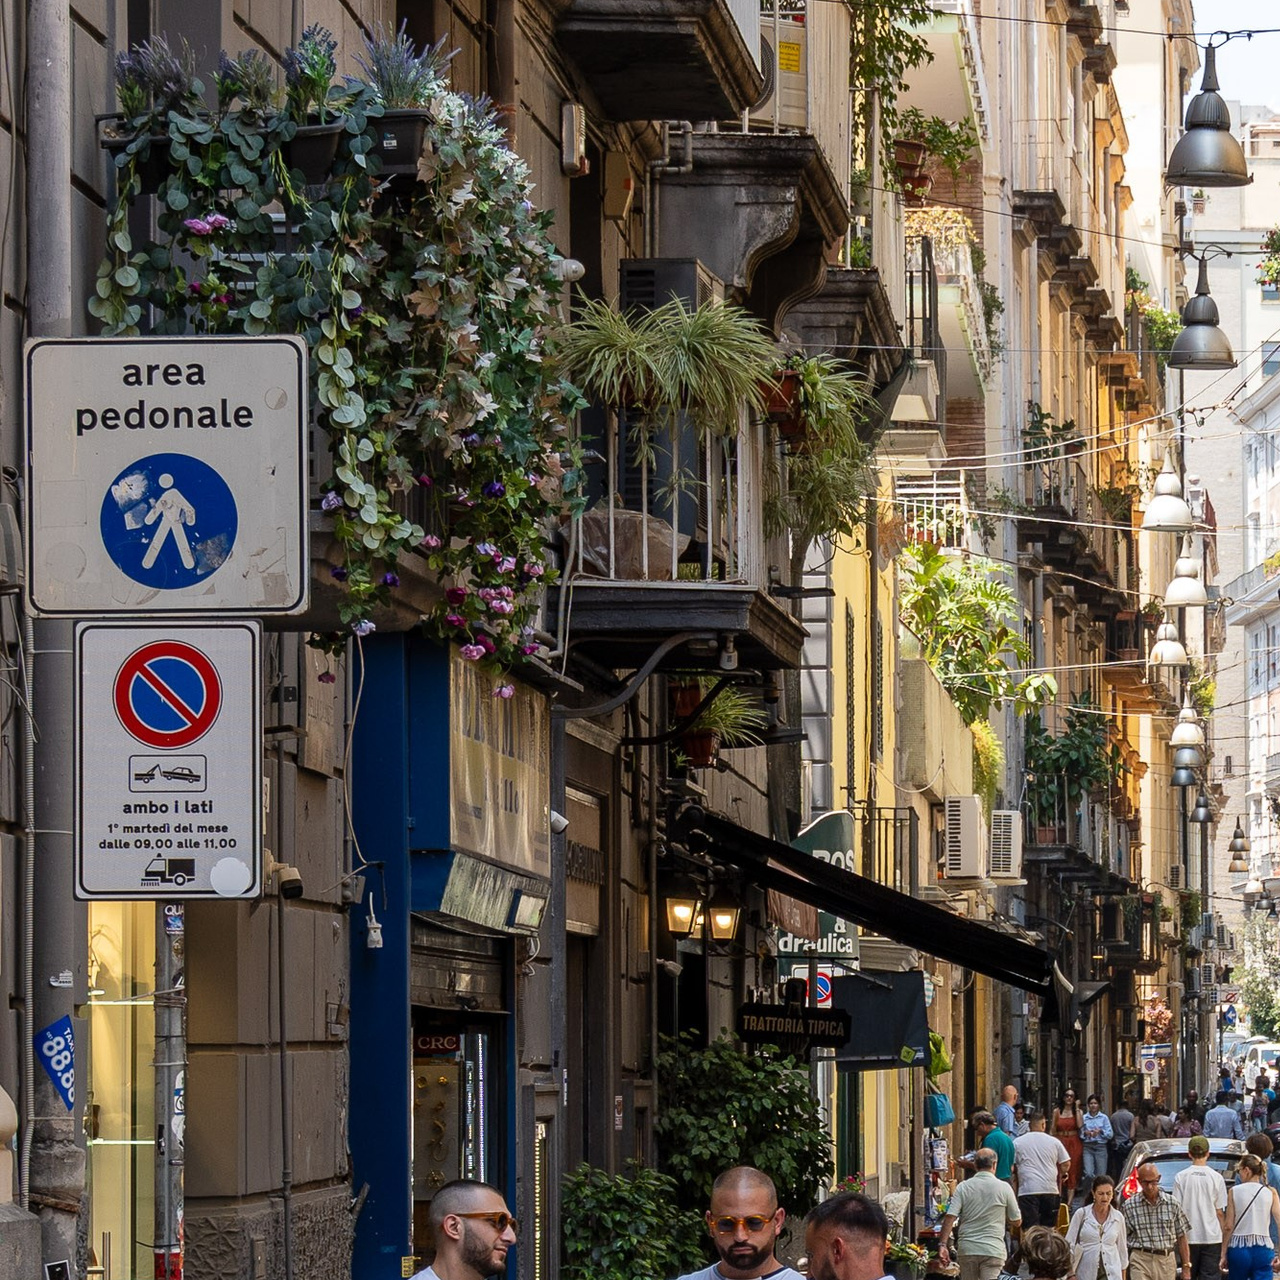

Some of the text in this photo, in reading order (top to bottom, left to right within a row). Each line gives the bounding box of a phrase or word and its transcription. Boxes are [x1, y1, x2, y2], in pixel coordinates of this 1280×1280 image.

[122, 363, 206, 386] area
[76, 399, 254, 436] pedonale
[123, 800, 213, 814] ambo i lati
[123, 823, 170, 833] martedì
[174, 823, 194, 833] del
[197, 825, 228, 833] mese
[99, 839, 130, 849] dalle
[177, 839, 200, 849] alle
[834, 917, 847, 933] &
[743, 1016, 845, 1037] TRATTORIA TIPICA
[417, 1036, 457, 1049] CRC
